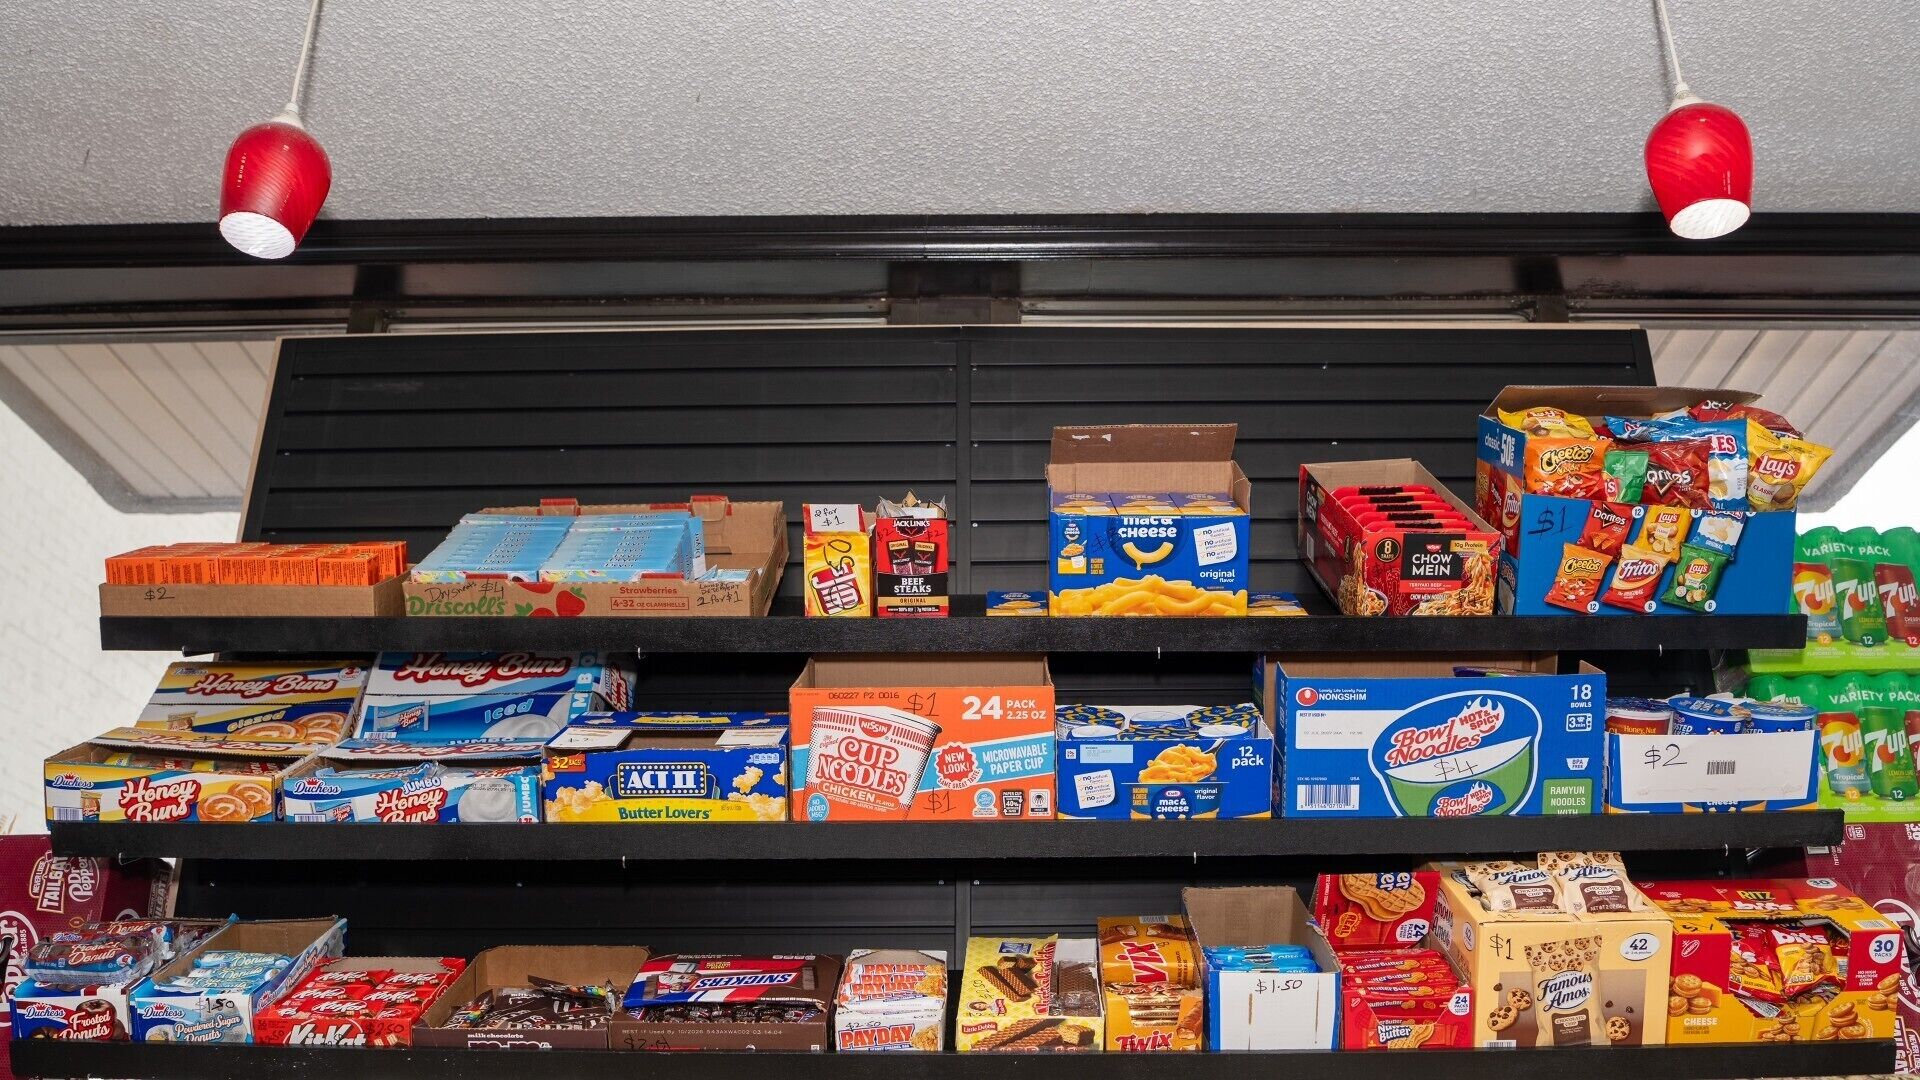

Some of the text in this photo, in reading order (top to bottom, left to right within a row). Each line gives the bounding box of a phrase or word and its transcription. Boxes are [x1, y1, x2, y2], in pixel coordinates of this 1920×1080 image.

[1541, 445, 1594, 474] Cheetos
[1758, 455, 1795, 478] Lay's
[1593, 509, 1626, 525] Doritos
[1634, 509, 1642, 517] 12
[1657, 513, 1678, 524] Lay's
[1528, 505, 1571, 541] $1
[1384, 541, 1392, 554] 8
[1803, 543, 1891, 556] VARIETY PACK
[1412, 554, 1452, 564] CHOW
[1564, 557, 1602, 575] Cheetos
[1200, 569, 1235, 580] original
[1412, 565, 1451, 576] MEIN
[1619, 560, 1659, 579] Fritos
[1689, 563, 1708, 574] Lay's
[479, 578, 505, 599] $4
[901, 578, 924, 586] BEEF
[144, 586, 175, 601] $2
[619, 586, 678, 595] Strawberries
[1793, 579, 1833, 617] 7up
[407, 596, 506, 616] Driscoll's
[613, 600, 635, 608] 4-32
[1589, 602, 1598, 611] 12
[1835, 579, 1877, 620] 7up
[1879, 582, 1917, 618] 7up
[1863, 636, 1873, 644] 12
[398, 652, 567, 682] Honey Buns
[193, 673, 336, 698] Honey Buns
[1570, 684, 1592, 701] 18
[903, 692, 940, 716] $1
[1006, 700, 1036, 708] PACK
[1319, 693, 1367, 701] NONGSHIM
[1829, 690, 1920, 704] VARIETY PACK
[484, 699, 534, 724] Iced
[961, 695, 1004, 720] 24
[1006, 711, 1047, 719] 2.25 OZ
[227, 710, 286, 732] Glazed
[1459, 710, 1484, 727] HOT
[1470, 712, 1500, 731] SPICY
[1569, 718, 1576, 728] 3
[860, 720, 888, 734] NISSIN
[1391, 718, 1455, 749] Bowl
[838, 736, 900, 770] CUP
[944, 752, 965, 763] NEW
[982, 742, 1048, 763] MICROWAVABLE
[1239, 746, 1253, 757] 12
[1386, 733, 1482, 768] Noodles
[1644, 743, 1688, 770] $2
[1821, 729, 1861, 773] 7up
[1864, 729, 1907, 773] 7up
[551, 756, 568, 768] 32
[943, 762, 970, 775] LOOK!
[990, 757, 1044, 775] PAPER CUP
[1232, 756, 1264, 770] pack
[1433, 757, 1479, 781] $4
[52, 775, 94, 790] Duchess
[627, 770, 697, 789] ACT II
[816, 754, 908, 798] NOODLES
[121, 778, 197, 806] Honey
[293, 779, 342, 795] Duchess
[403, 777, 441, 795] JUMBO
[822, 782, 876, 803] CHICKEN
[952, 781, 968, 789] GREAT
[1194, 788, 1218, 796] original
[1550, 785, 1585, 795] RAMYUN
[376, 789, 447, 815] Honey
[923, 787, 956, 814] $1
[1438, 795, 1469, 809] Bowl
[1550, 797, 1586, 806] NOODLES
[1892, 790, 1904, 799] 12
[127, 801, 187, 822] Buns
[618, 806, 710, 820] Butter Lovers
[1739, 890, 1776, 902] RITZ
[1734, 900, 1793, 912] bits
[1413, 924, 1426, 938] 24
[1771, 929, 1829, 944] bits
[1489, 933, 1514, 961] $1
[1630, 939, 1648, 951] 42
[1873, 939, 1895, 952] 30
[698, 972, 794, 989] SNICKERS
[1255, 979, 1303, 994] $1.50
[1536, 972, 1593, 1002] Famous
[1454, 996, 1468, 1004] 24
[25, 1006, 66, 1019] Duchess
[142, 1006, 186, 1019] Duchess
[1555, 1014, 1586, 1024] CHOCOLATE
[69, 1010, 111, 1032] Frosted
[174, 1014, 243, 1036] Powdered Sugar
[1684, 1018, 1718, 1026] CHEESE
[839, 1023, 915, 1050] PAYDAY
[1115, 1030, 1174, 1051] Twix
[1379, 1026, 1412, 1042] Butter
